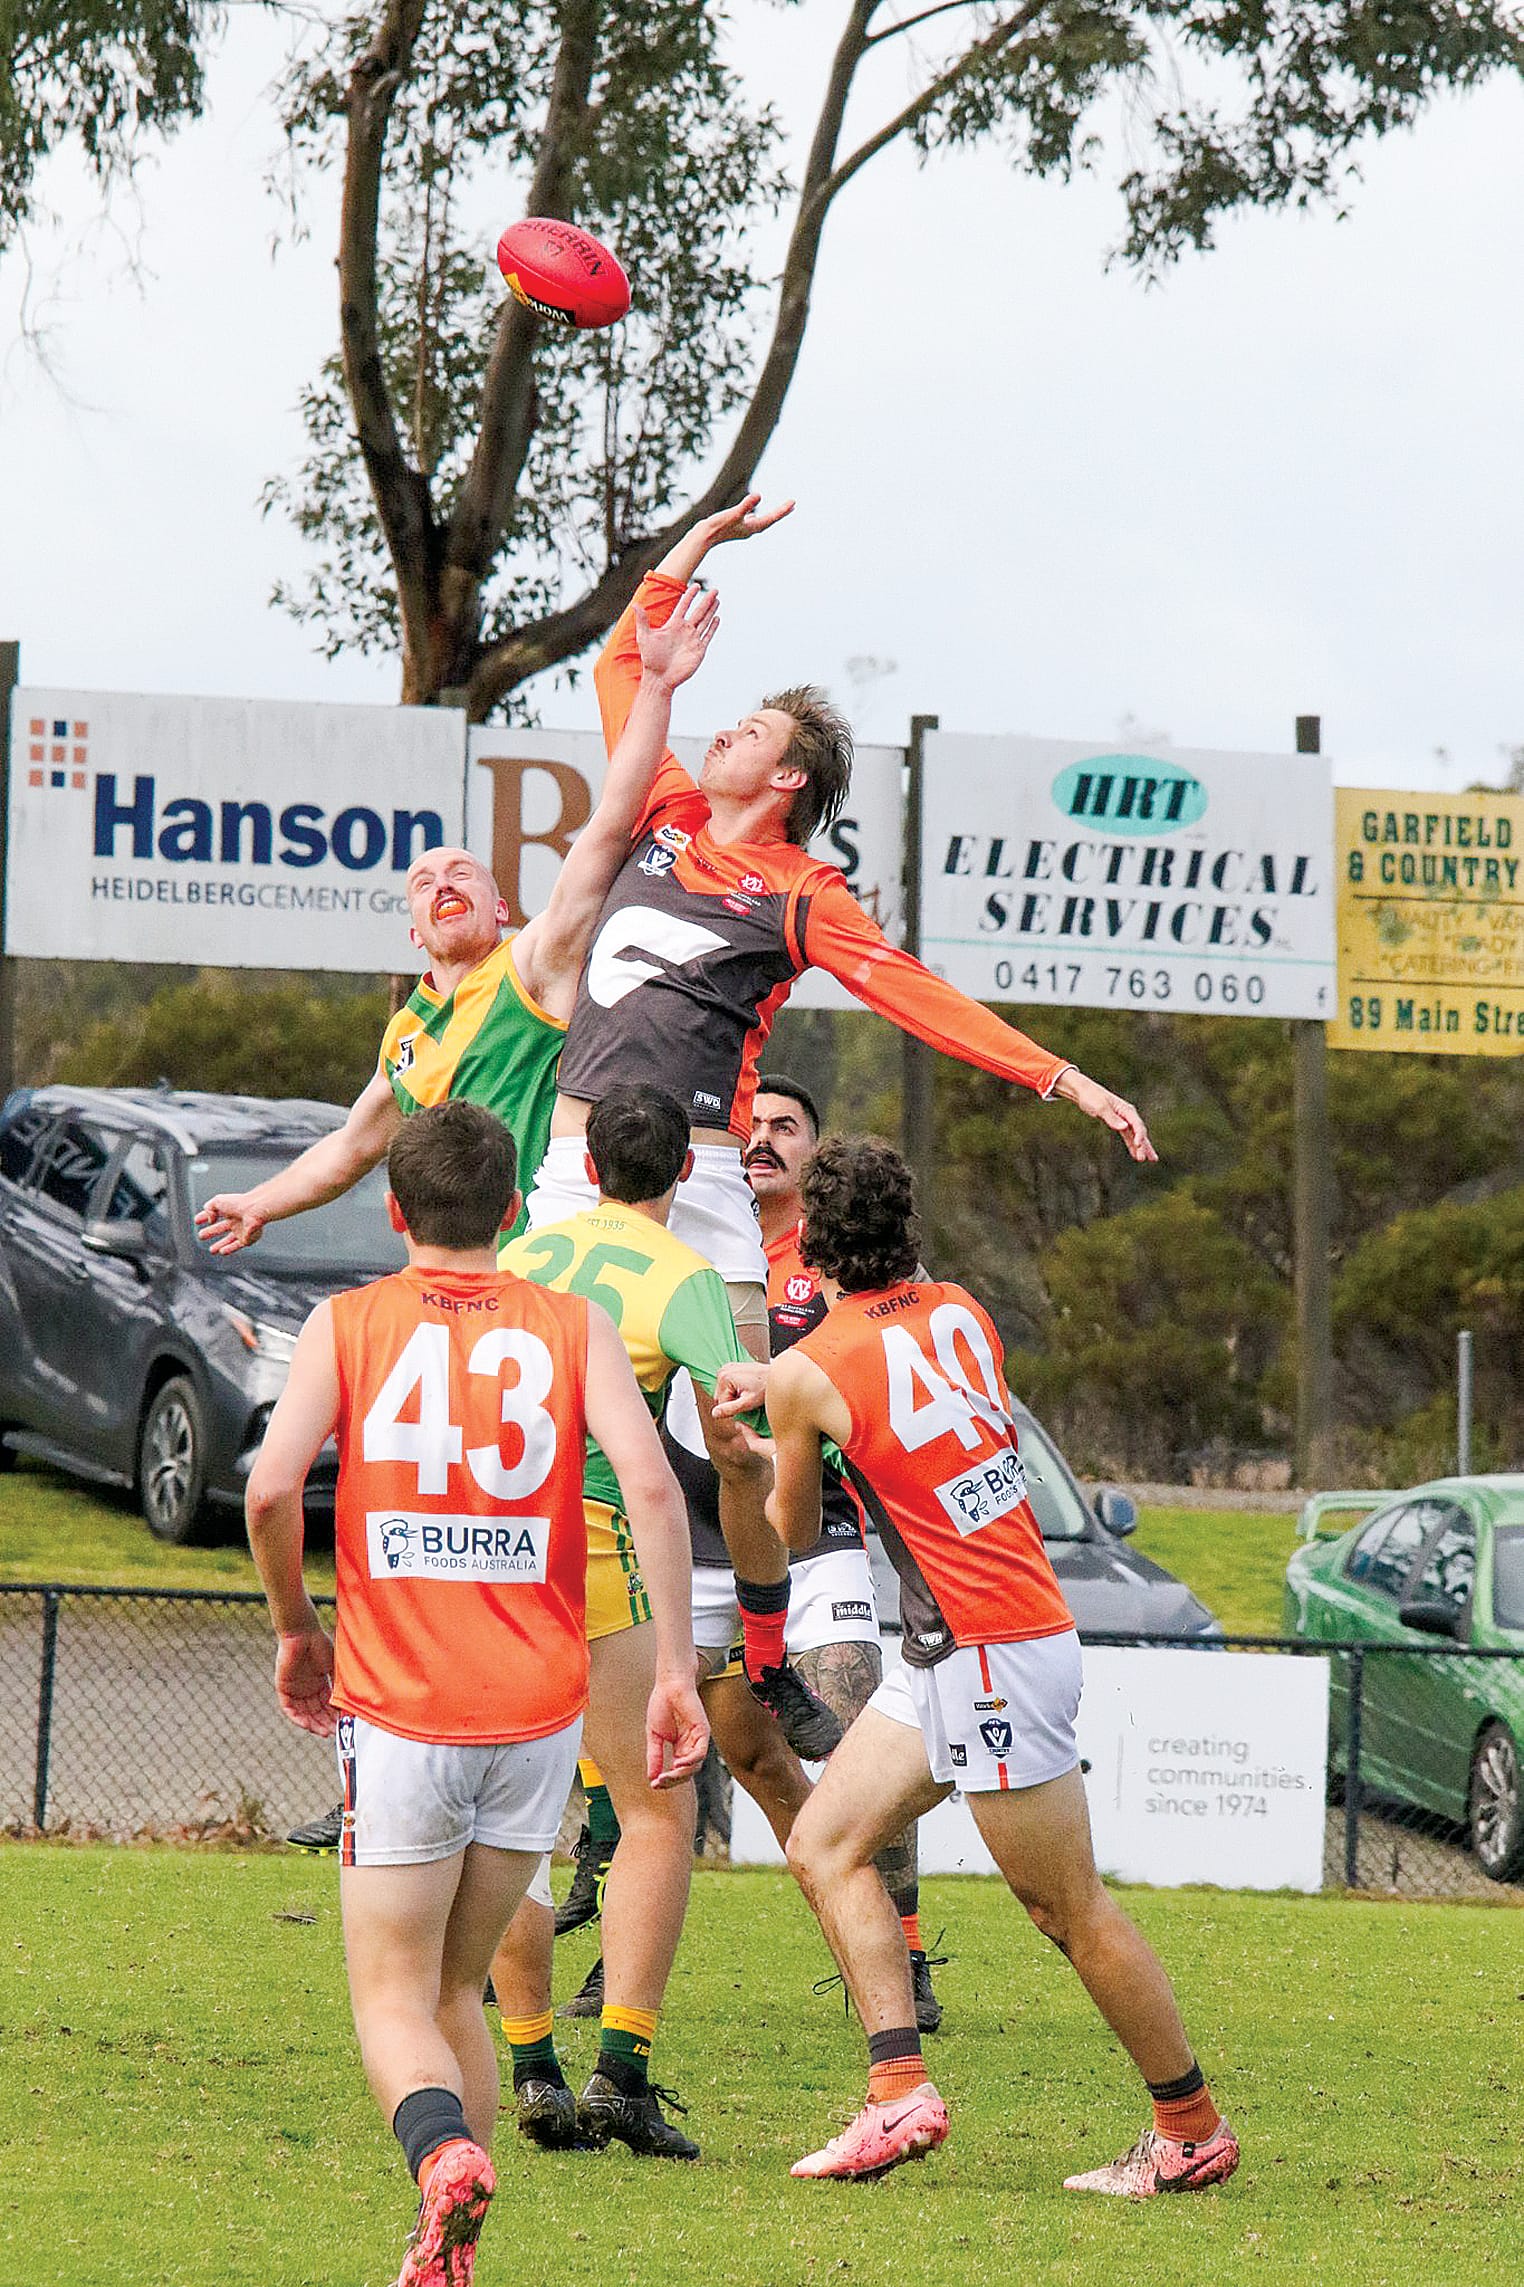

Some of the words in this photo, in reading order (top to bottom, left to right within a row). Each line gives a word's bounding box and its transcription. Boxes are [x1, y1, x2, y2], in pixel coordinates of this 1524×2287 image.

[1069, 774, 1199, 821] HRT
[93, 774, 444, 870] Hanson
[1362, 811, 1511, 849] GARFIELD
[943, 835, 1318, 896] ELECTRICAL
[1381, 852, 1519, 888] COUNTRY
[91, 877, 365, 912] HEIDELBERGCEMENT
[977, 891, 1279, 950] SERVICES
[995, 961, 1082, 995] 0417
[1106, 967, 1171, 999] 763
[1195, 972, 1265, 1004] 060
[1350, 996, 1381, 1029] 89
[1396, 999, 1460, 1033] Main
[421, 1292, 499, 1315] KBFNC
[863, 1291, 921, 1319] KBFNC
[881, 1303, 1014, 1453] 40
[363, 1322, 556, 1501] 43
[422, 1525, 537, 1558] BURRA
[424, 1556, 467, 1569] FOODS
[471, 1558, 537, 1571] AUSTRALIA
[1148, 1735, 1250, 1764] creating
[1145, 1791, 1208, 1817] since
[1216, 1794, 1268, 1817] 1974
